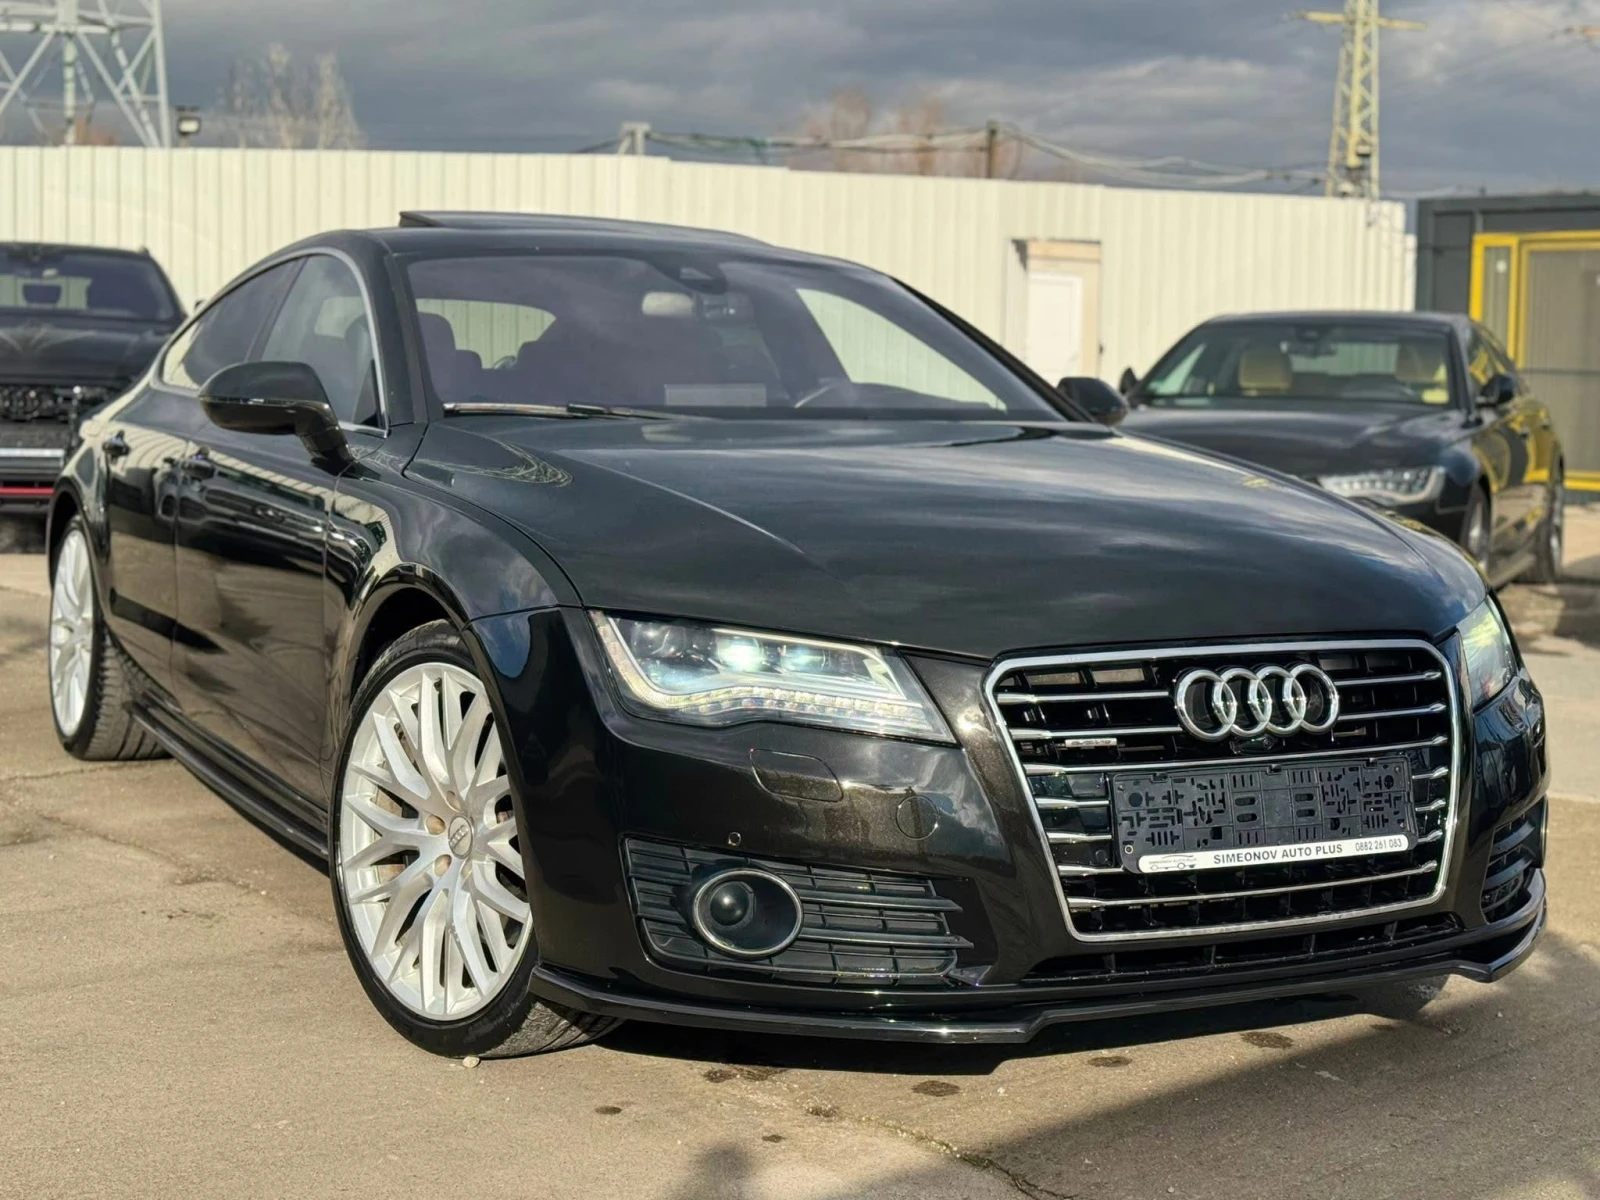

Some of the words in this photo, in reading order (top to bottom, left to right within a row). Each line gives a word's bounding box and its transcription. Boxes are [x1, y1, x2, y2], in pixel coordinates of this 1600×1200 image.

[1355, 841, 1373, 851] 0882
[1374, 839, 1387, 850] 261
[1388, 838, 1402, 848] 083
[1213, 850, 1277, 864] SIMEONOV
[1281, 846, 1312, 858] AUTO
[1315, 844, 1343, 855] PLUS
